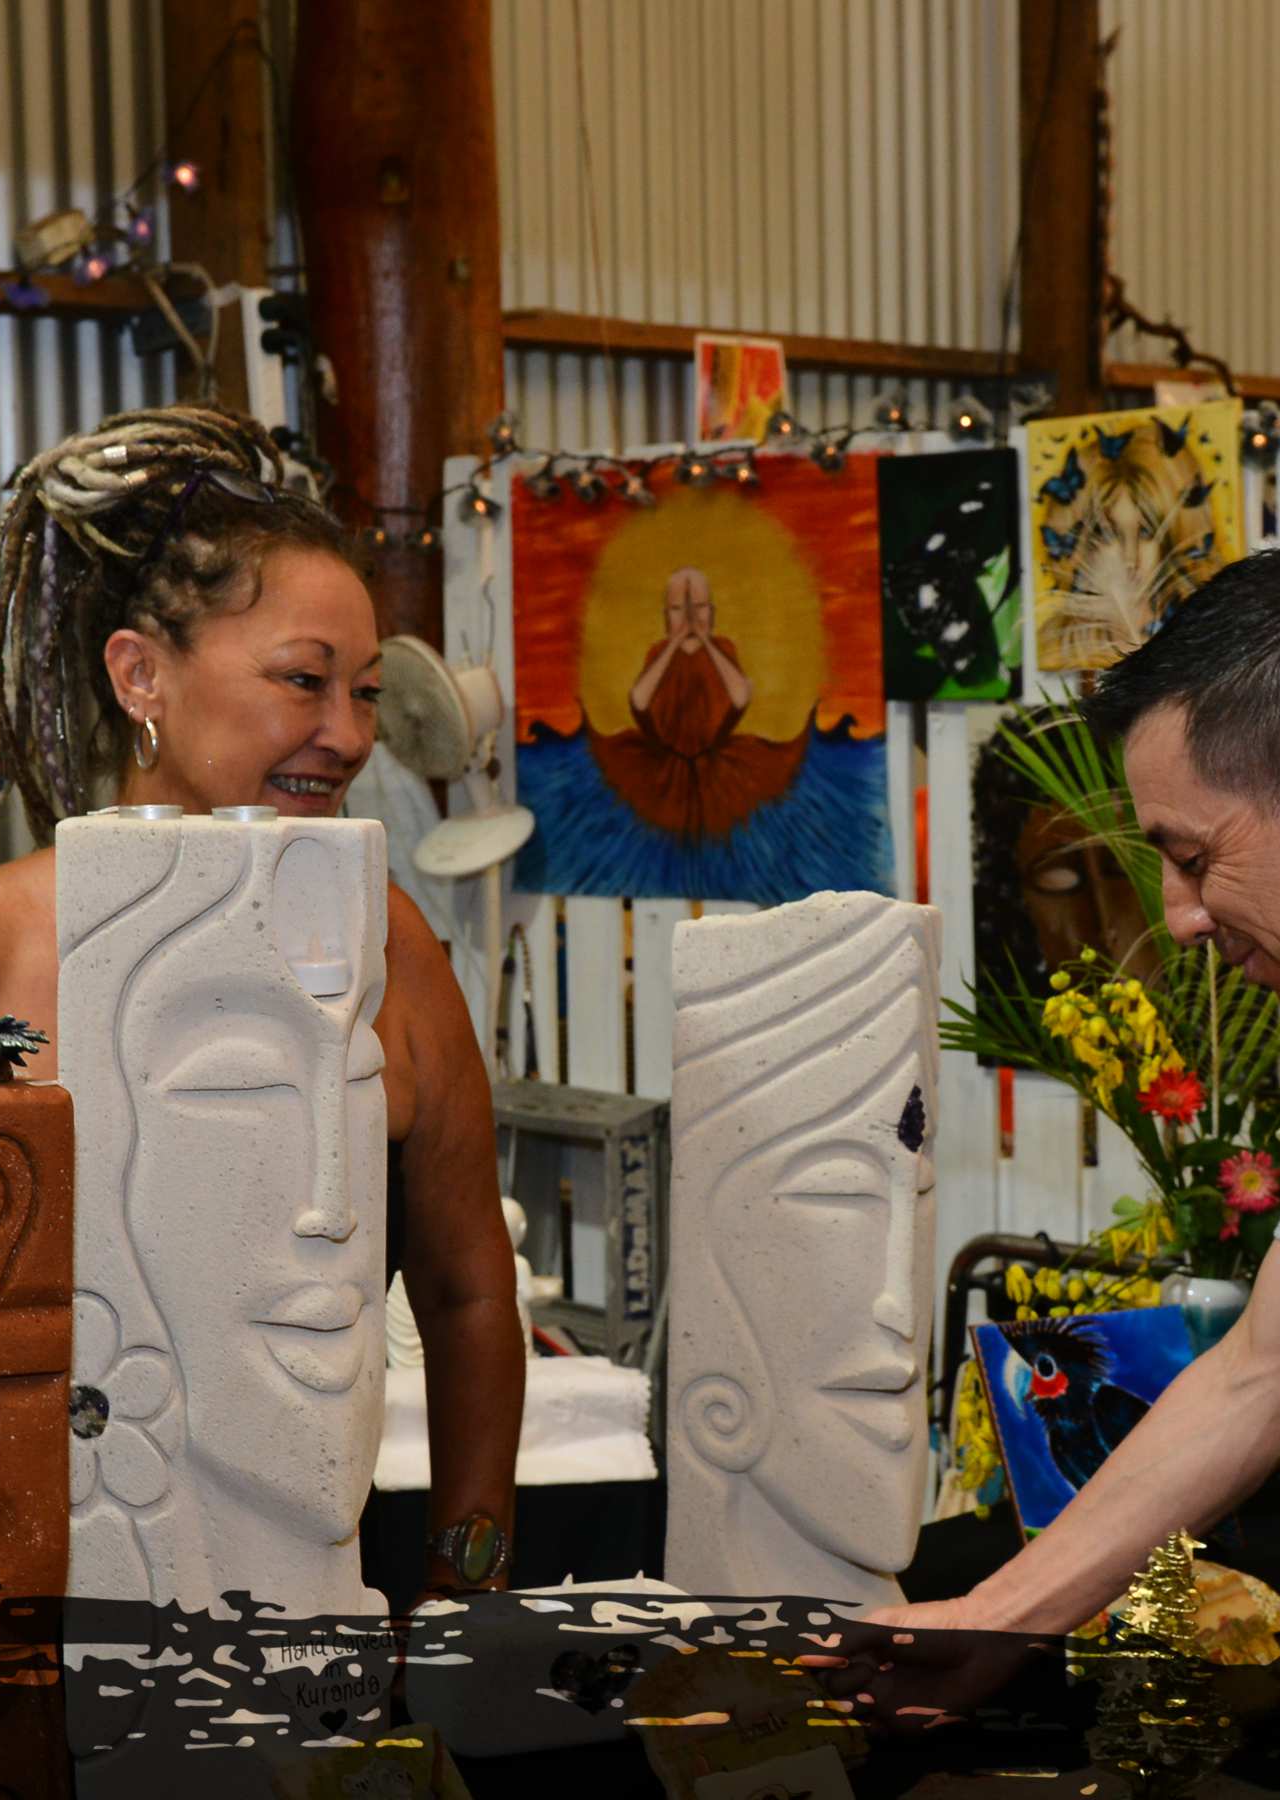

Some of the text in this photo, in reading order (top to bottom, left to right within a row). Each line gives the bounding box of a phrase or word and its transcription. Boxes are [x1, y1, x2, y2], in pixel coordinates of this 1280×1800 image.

[281, 1634, 328, 1662] Hand
[324, 1658, 342, 1677] in
[296, 1673, 380, 1708] Kuranda
